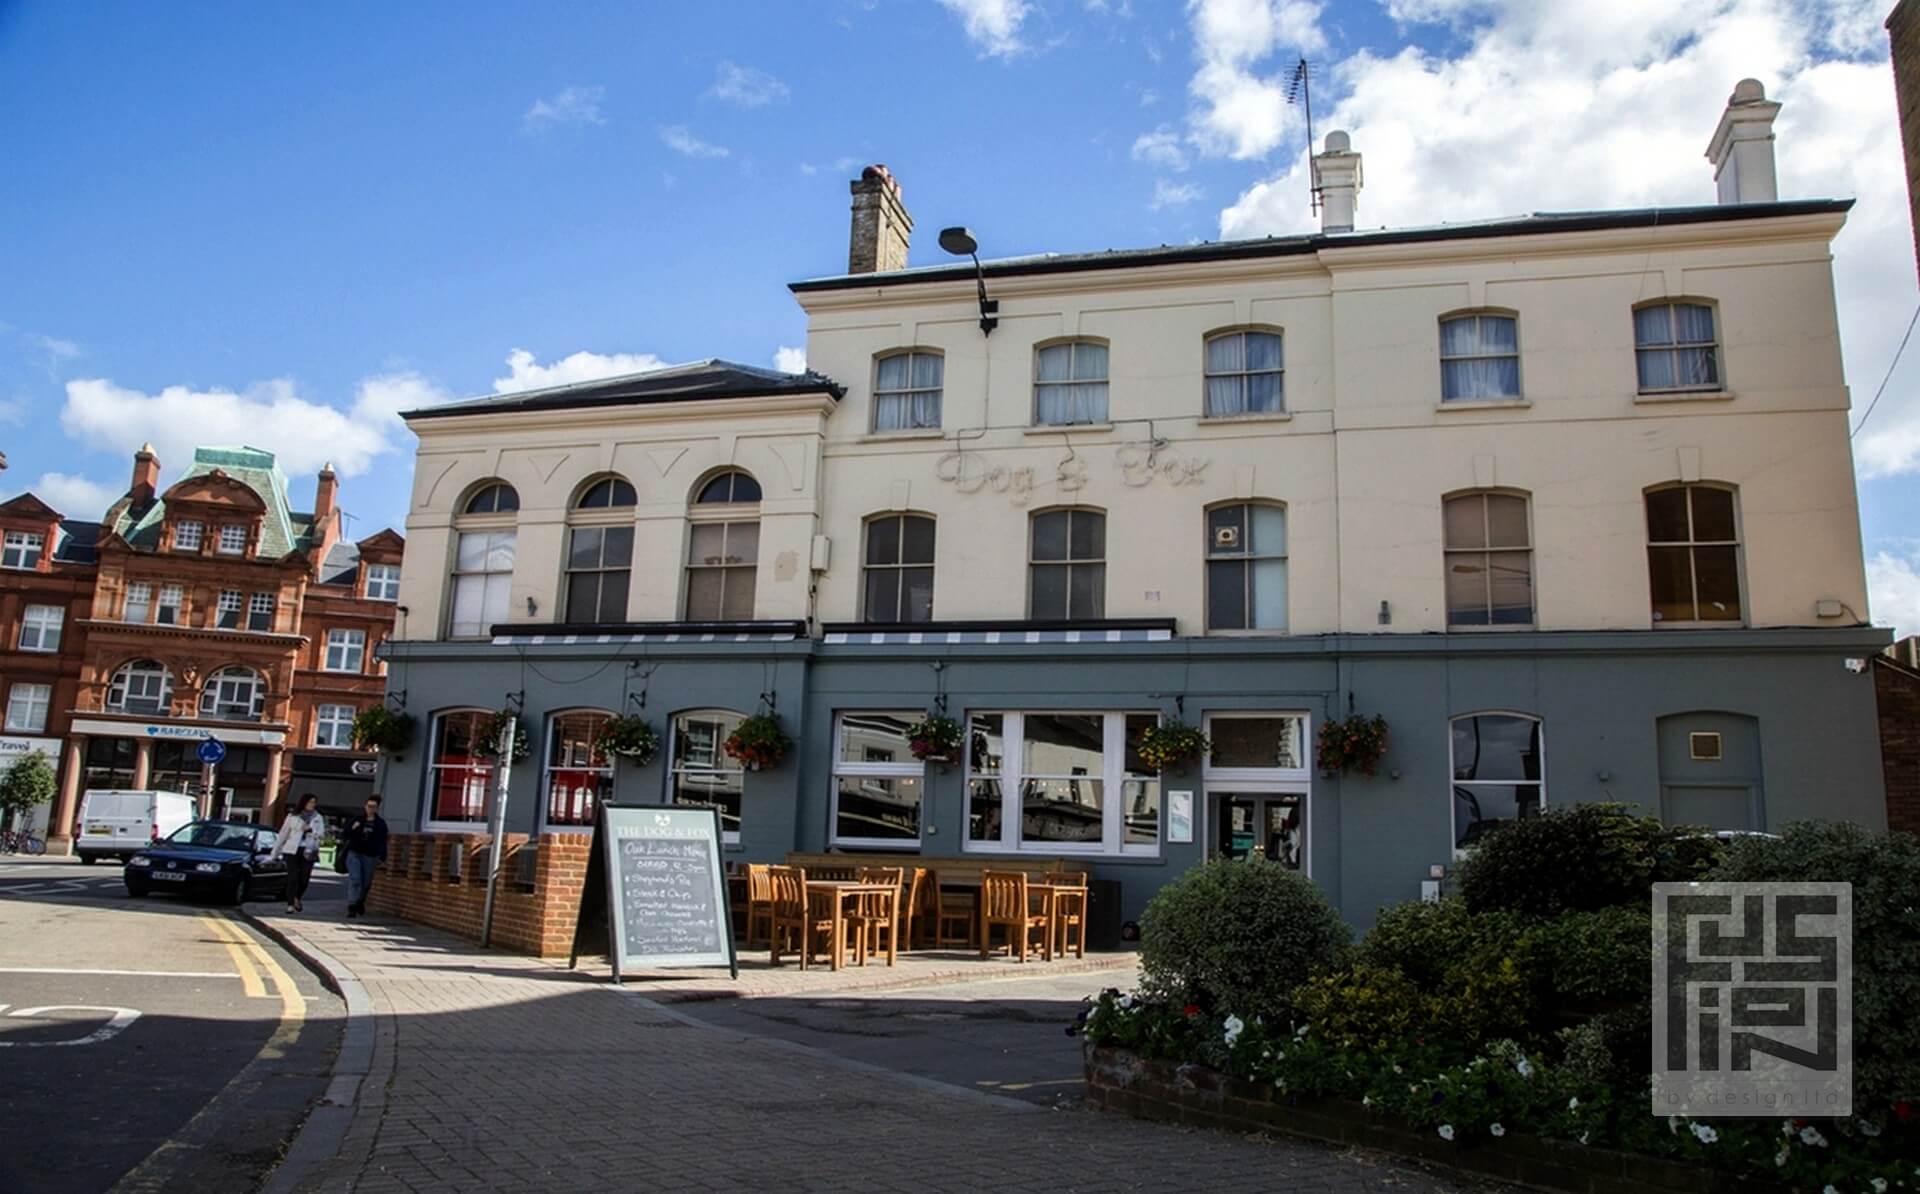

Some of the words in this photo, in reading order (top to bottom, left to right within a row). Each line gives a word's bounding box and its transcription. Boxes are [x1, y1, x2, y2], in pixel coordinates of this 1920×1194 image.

[160, 727, 210, 738] BARCLAYS
[616, 826, 640, 837] THE
[644, 826, 673, 838] DOG
[675, 828, 683, 837] &
[687, 827, 710, 839] FOX
